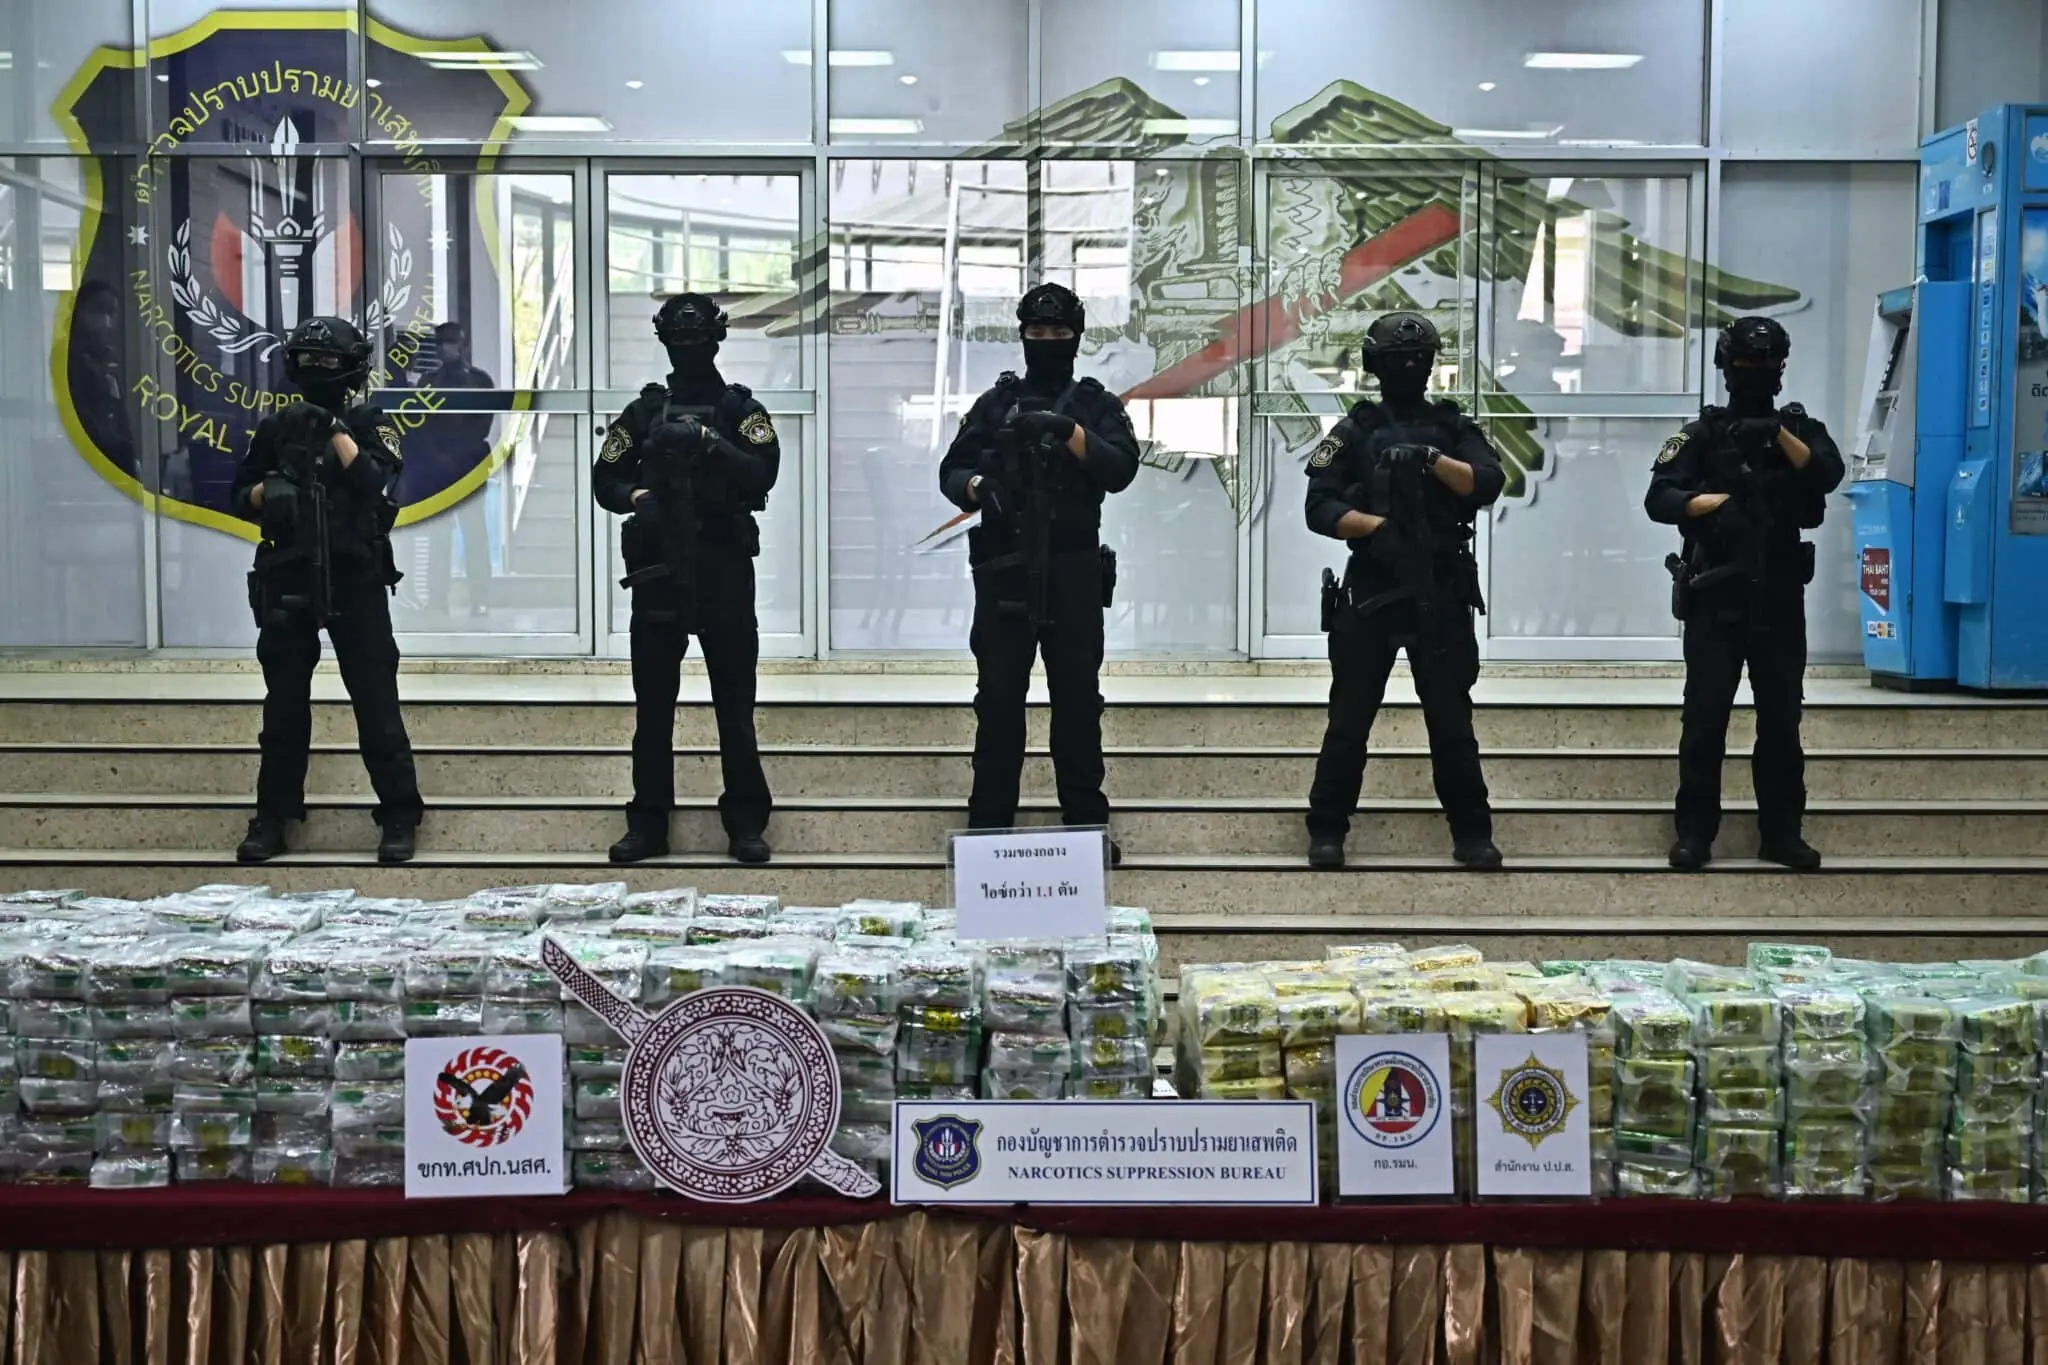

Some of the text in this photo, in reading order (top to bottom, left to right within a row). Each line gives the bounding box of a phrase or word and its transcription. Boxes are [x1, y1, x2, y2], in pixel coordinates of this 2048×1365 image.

[129, 269, 224, 392] NARCOTICS
[132, 374, 232, 453] ROYAL
[993, 847, 1067, 858] รวมของกลาง
[1037, 886, 1053, 897] 1.1
[1058, 881, 1078, 897] ตัน
[997, 1127, 1297, 1158] กองบัญชาการตำรวจปราบปรามยาเสพติด
[417, 1156, 552, 1178] ขกท.ศปก.นสศ.
[1008, 1166, 1287, 1180] NARCOTICS SUPPRESSION BUREAU
[1374, 1159, 1418, 1169] กอ.รมน.
